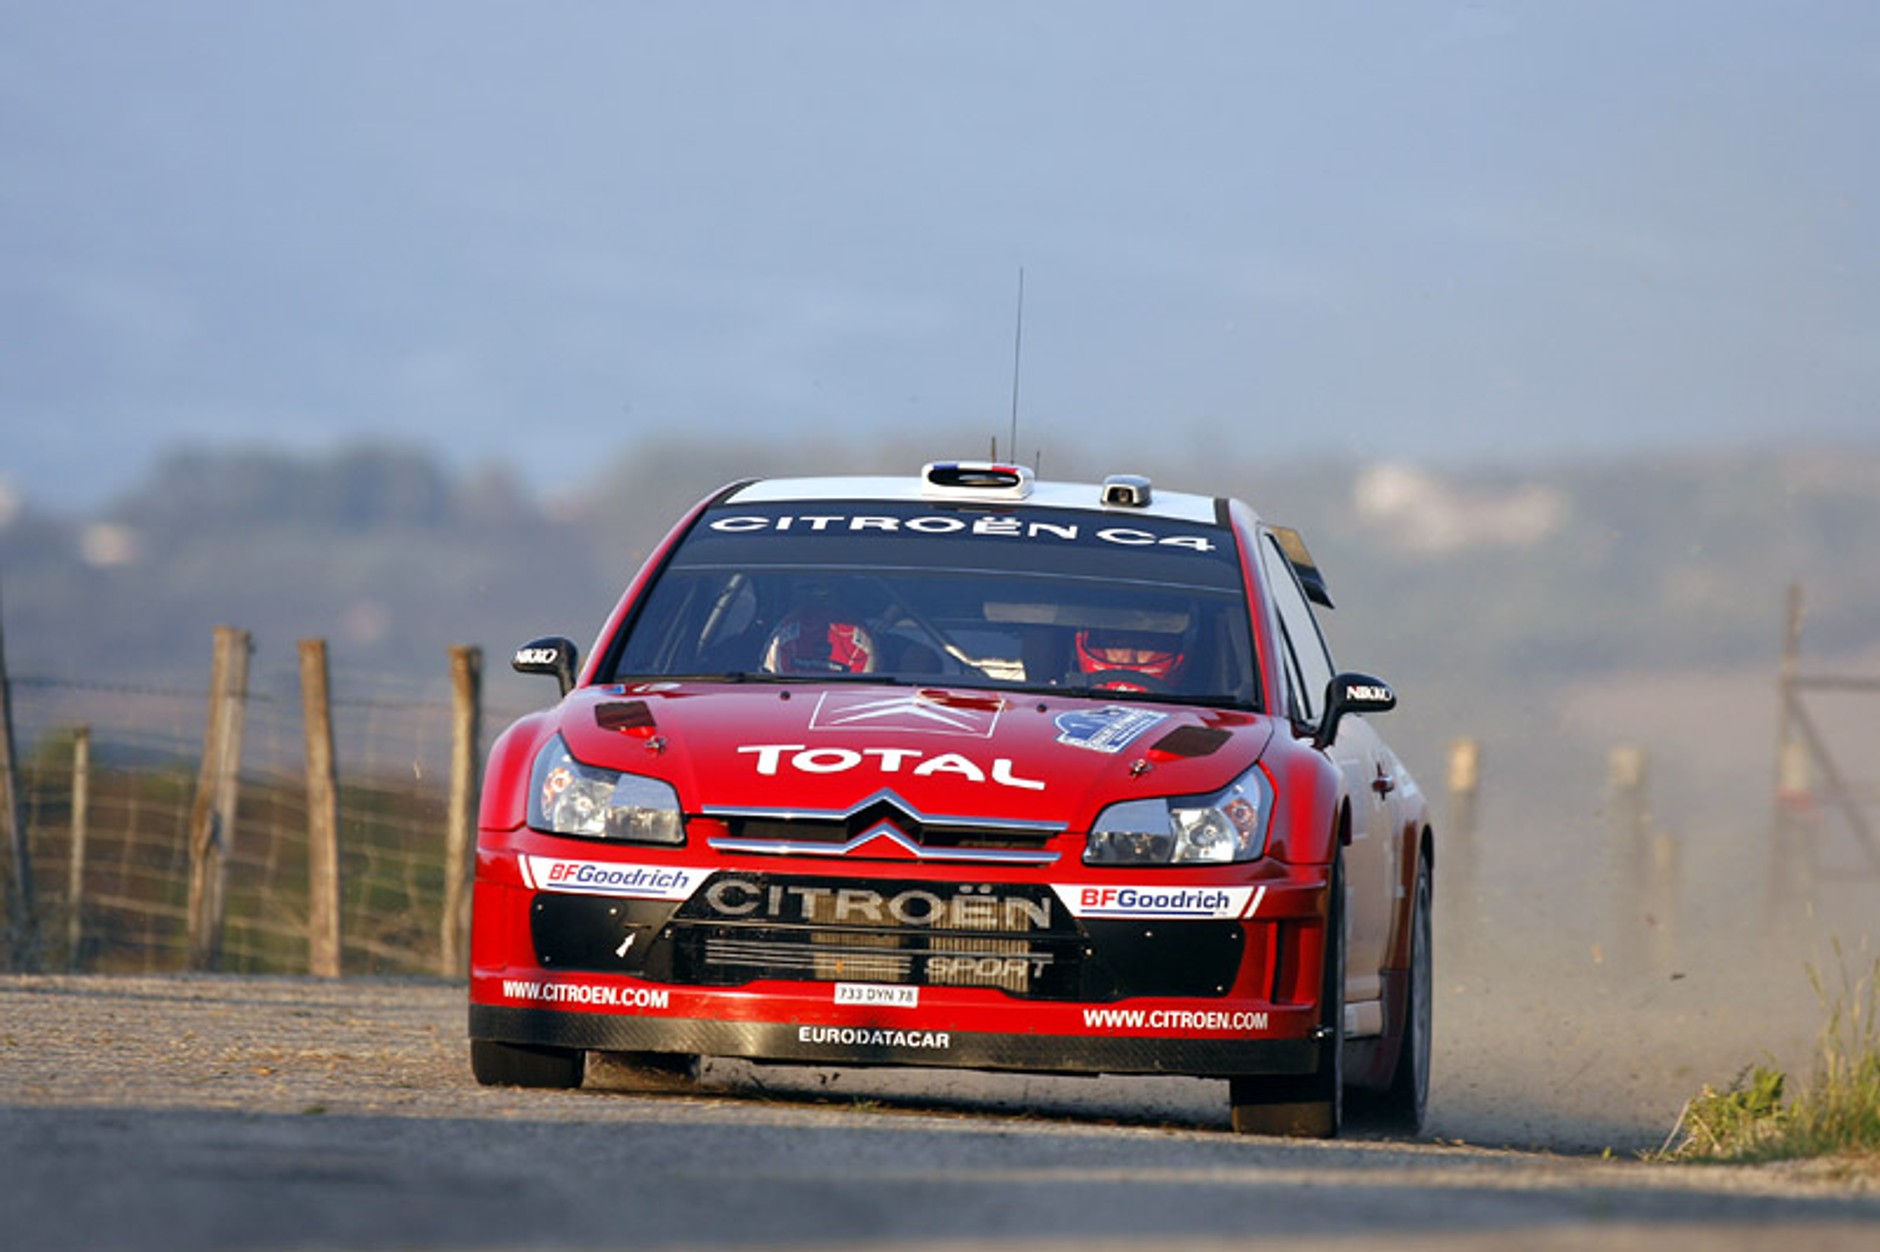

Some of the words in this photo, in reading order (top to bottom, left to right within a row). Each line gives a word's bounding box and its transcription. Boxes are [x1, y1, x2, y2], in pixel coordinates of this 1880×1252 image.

[709, 514, 1079, 540] CITROËN
[1096, 528, 1216, 552] C4
[737, 743, 1046, 791] TOTAL
[548, 863, 690, 889] BFGoodrich
[705, 878, 1052, 929] CITROËN
[1080, 887, 1231, 910] BFGoodrich
[924, 956, 1047, 979] SPORT
[502, 980, 670, 1009] WWW.CITROEN.COM
[840, 987, 864, 1000] 733
[867, 988, 895, 1001] DYN
[1083, 1009, 1269, 1031] WWW.CITROEN.COM
[799, 1026, 950, 1049] EURODATACAR
